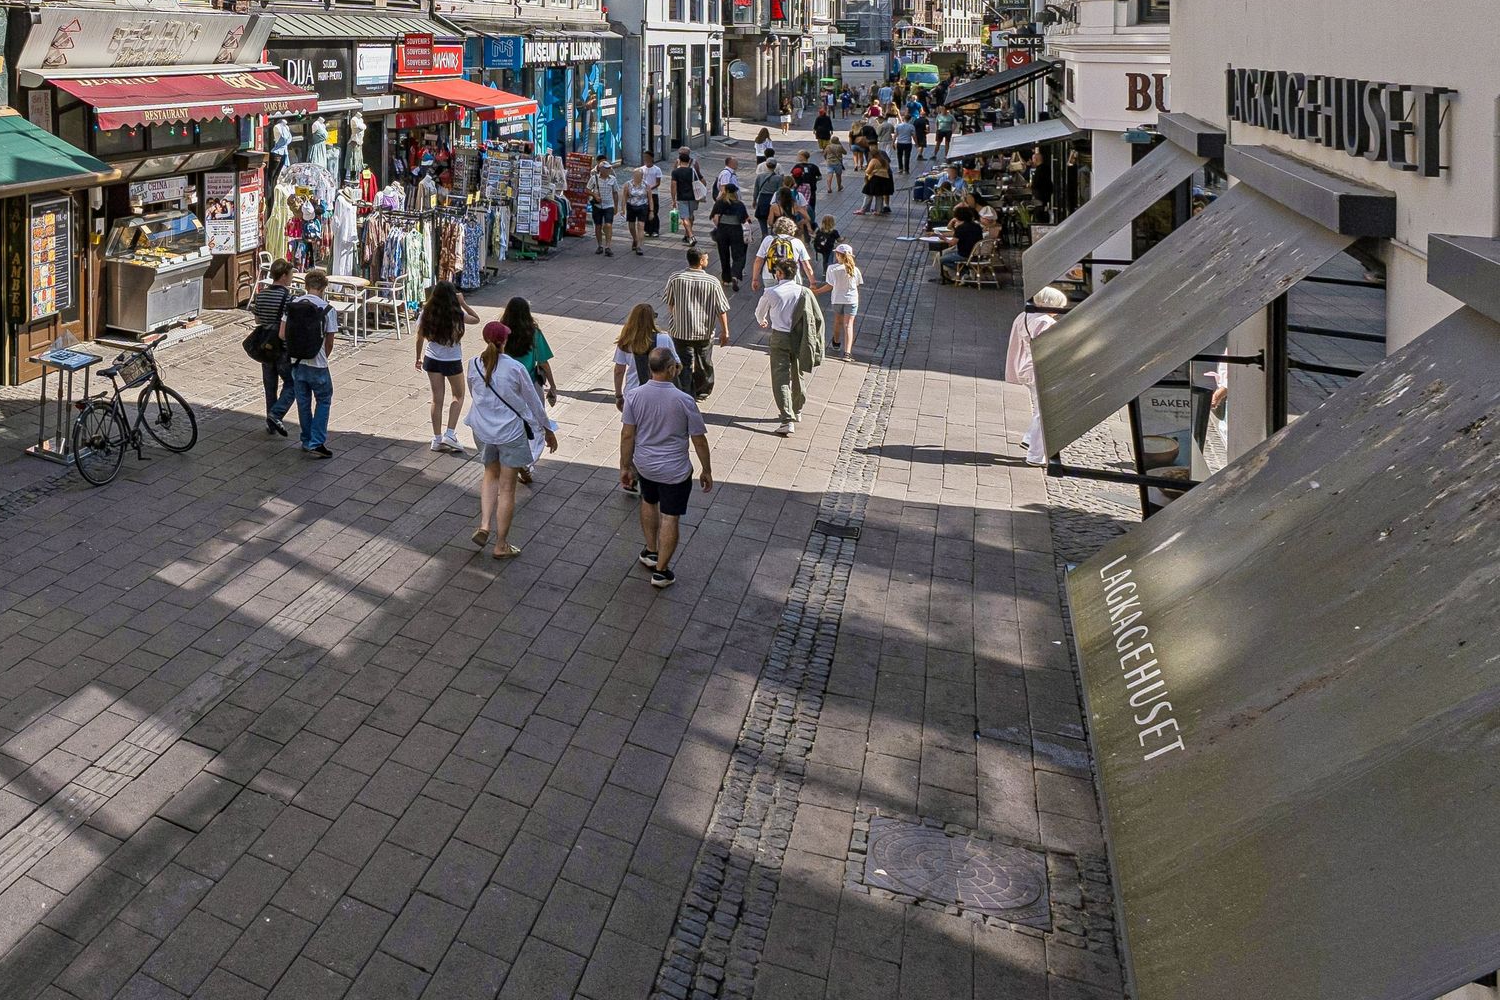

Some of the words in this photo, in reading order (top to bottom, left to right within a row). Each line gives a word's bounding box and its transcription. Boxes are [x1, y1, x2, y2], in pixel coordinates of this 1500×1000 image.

[1008, 37, 1042, 45] NEYE
[524, 42, 557, 63] MUSEUM
[558, 42, 569, 60] OF
[570, 42, 602, 60] ILLUSIONS
[278, 101, 289, 111] BAR
[144, 107, 189, 122] RESTAURANT
[147, 180, 168, 191] CHINA
[151, 191, 166, 201] BOX
[10, 252, 22, 318] AMBER
[1151, 398, 1191, 408] BAKER
[1099, 554, 1185, 761] LAGKAGEHUSET
